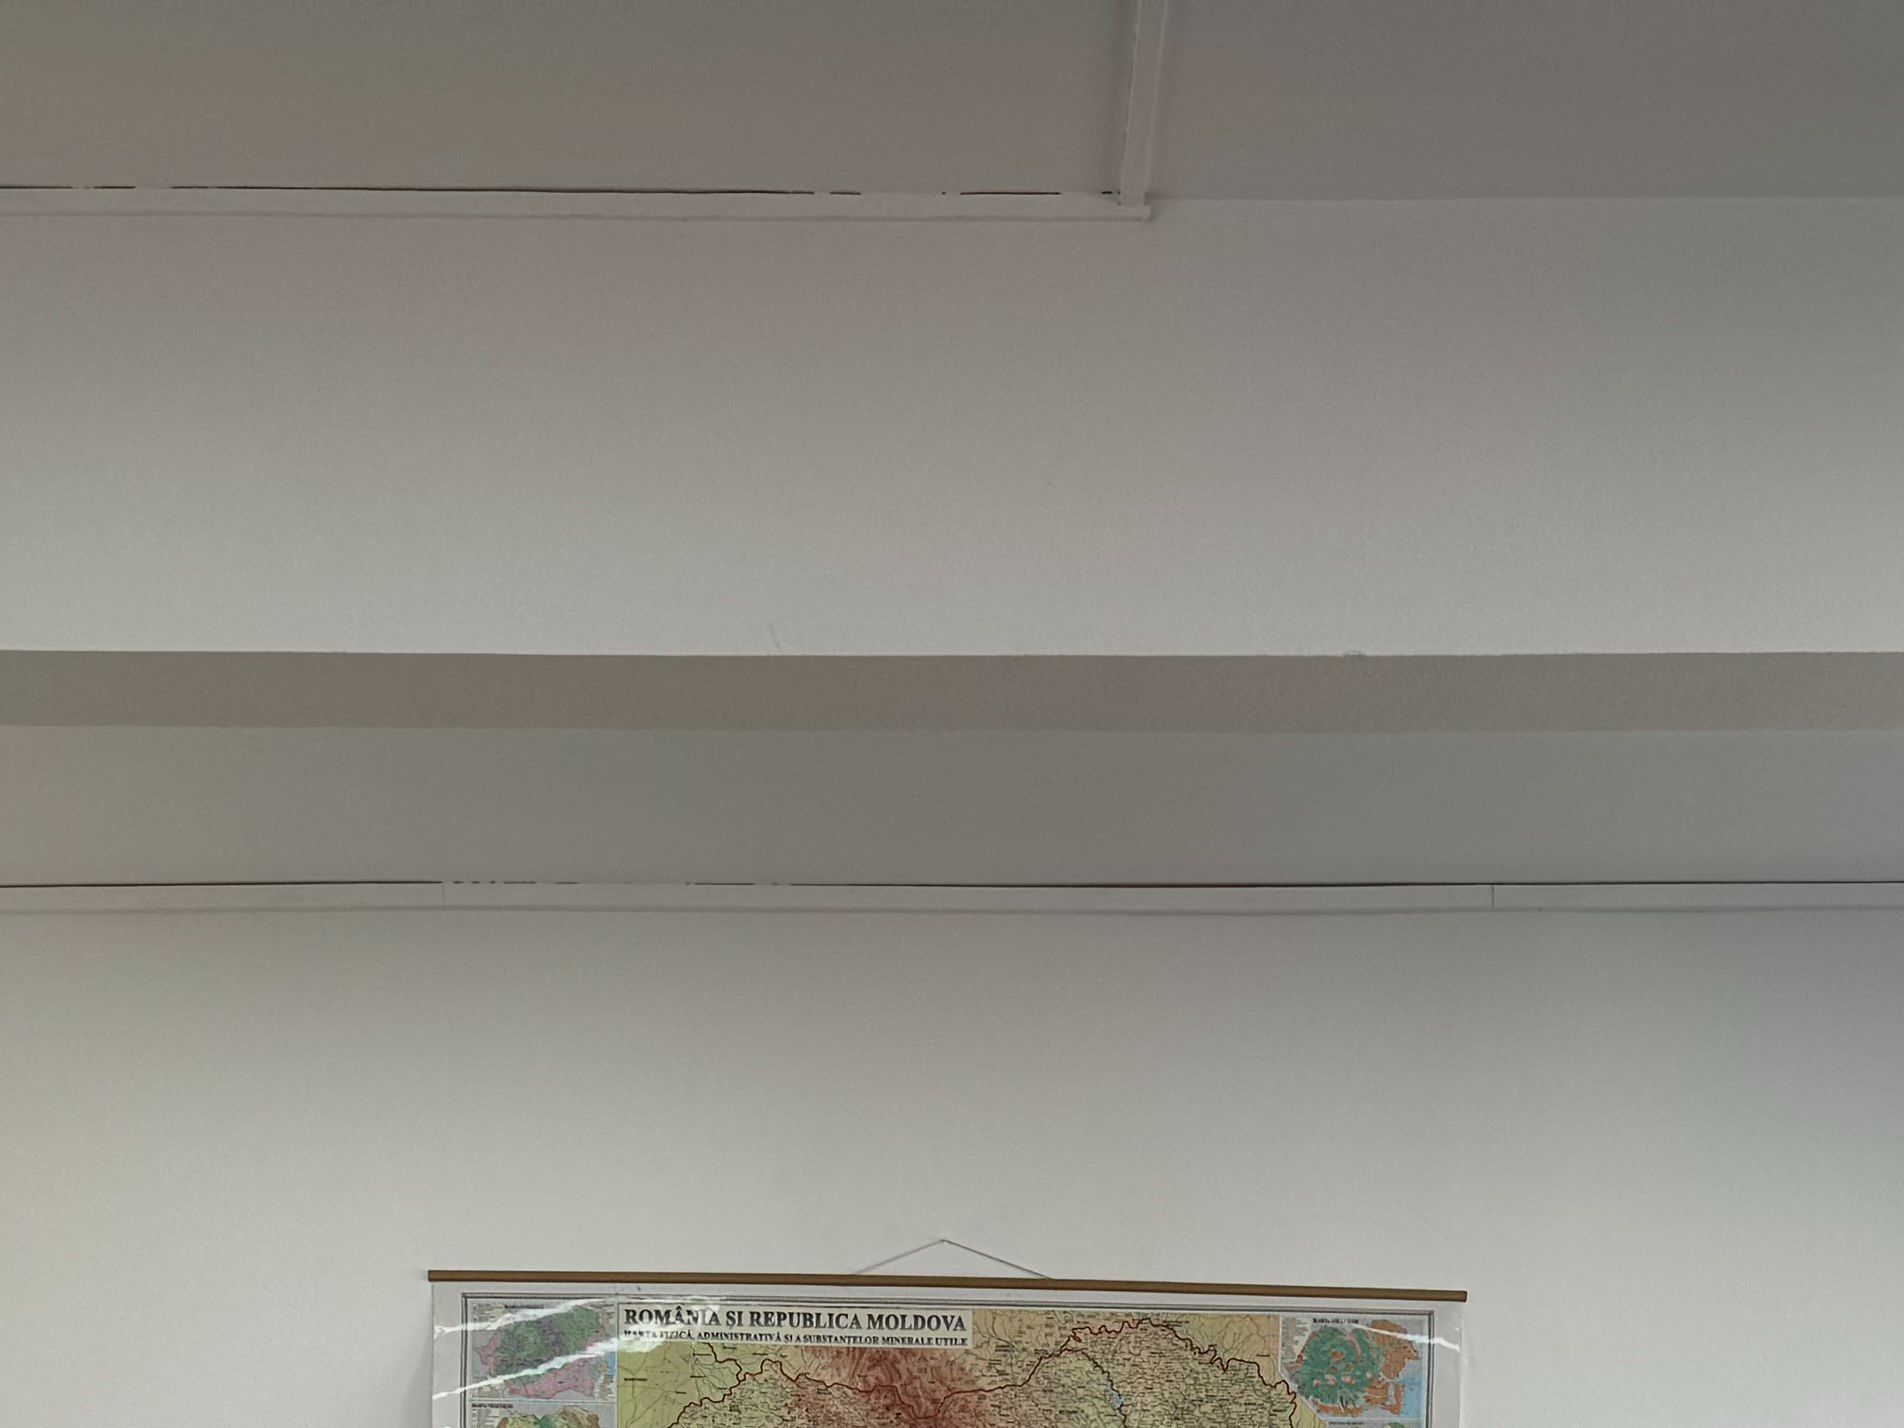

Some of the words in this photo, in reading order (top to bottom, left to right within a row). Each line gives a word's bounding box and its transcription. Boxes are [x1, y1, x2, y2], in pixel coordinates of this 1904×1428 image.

[624, 1305, 720, 1326] ROMÂNIA
[749, 1310, 863, 1331] REPUBLICA
[866, 1313, 967, 1332] MOLDOVA
